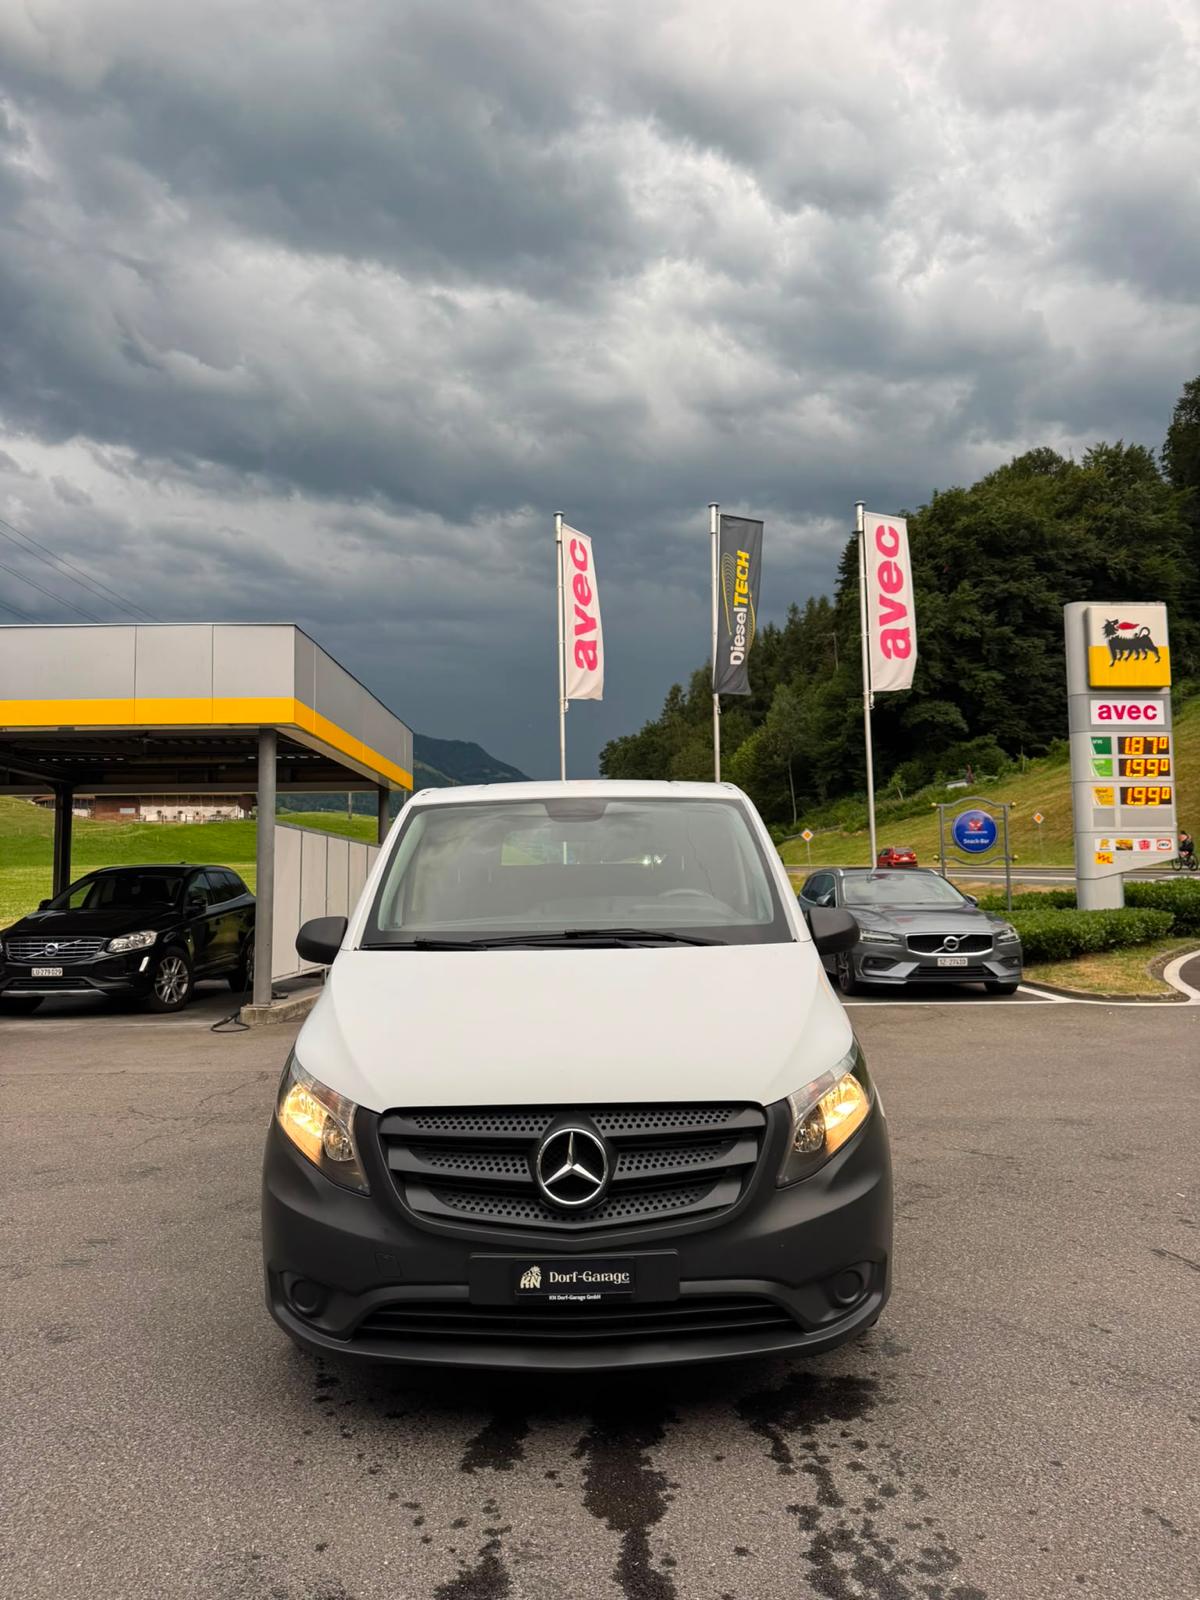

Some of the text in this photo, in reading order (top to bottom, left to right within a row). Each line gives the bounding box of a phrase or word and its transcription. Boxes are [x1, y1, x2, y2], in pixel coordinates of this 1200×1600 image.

[569, 538, 598, 671] avec
[875, 525, 912, 660] avec
[1097, 704, 1158, 721] avec
[549, 1270, 630, 1284] Dorf-Garage
